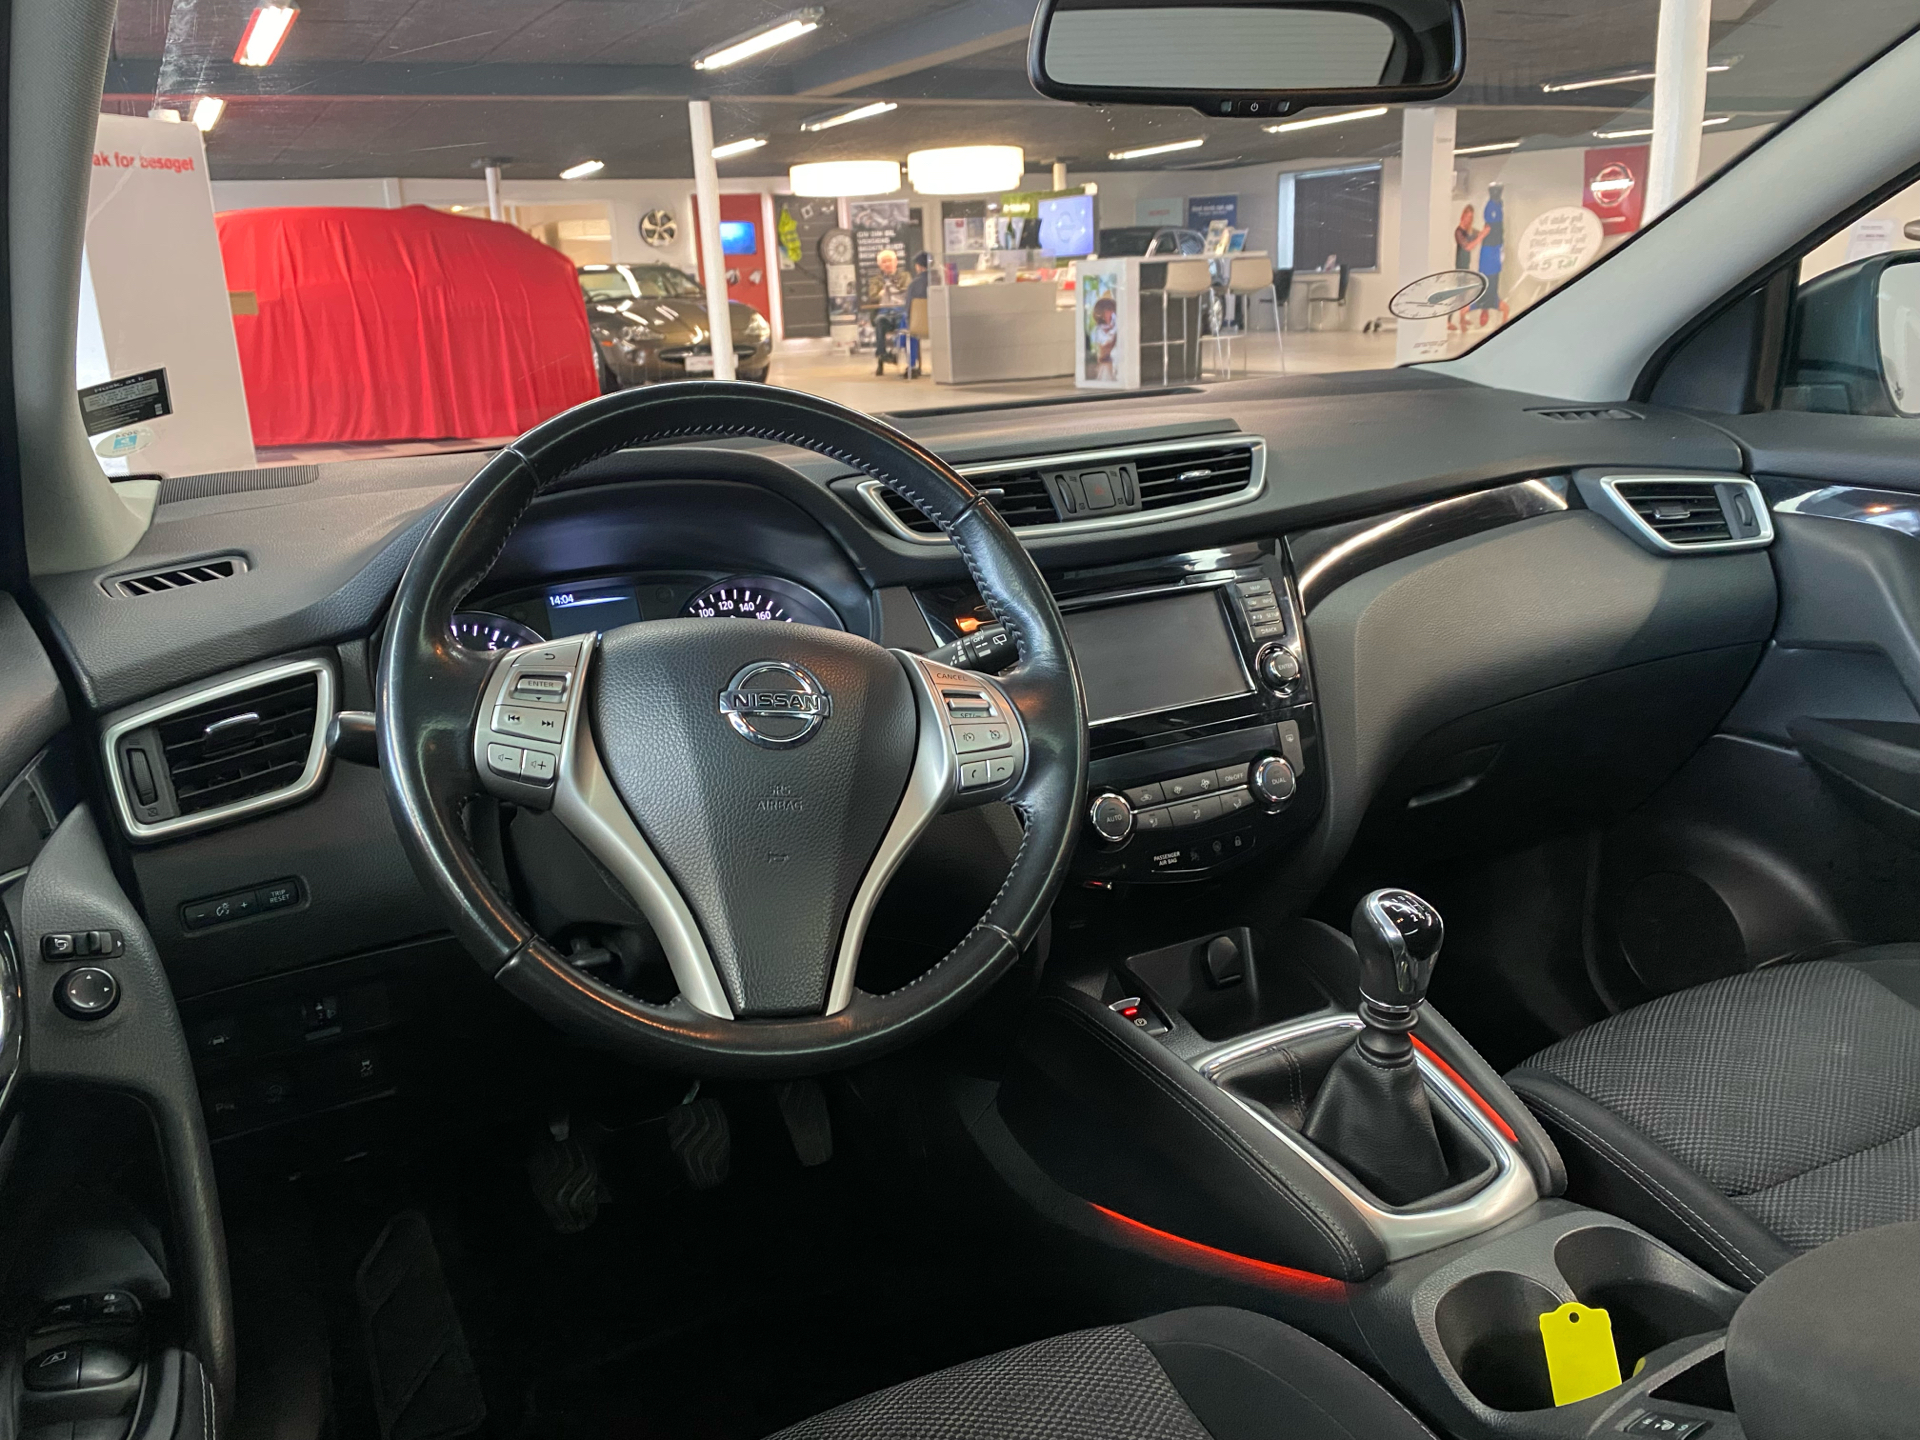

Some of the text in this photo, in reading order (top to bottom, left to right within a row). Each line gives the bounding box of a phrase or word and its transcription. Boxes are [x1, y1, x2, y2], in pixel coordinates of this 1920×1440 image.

[114, 151, 135, 168] for
[549, 594, 574, 605] 14:04
[718, 601, 734, 610] 120
[739, 602, 755, 612] 140
[698, 608, 715, 618] 100
[756, 611, 771, 621] 160
[936, 672, 968, 682] CANCEL
[527, 680, 555, 688] ENTER
[733, 692, 821, 712] NISSAN
[1271, 777, 1287, 785] DUAL
[756, 800, 803, 812] AIRBAG
[1106, 813, 1123, 823] AUTO
[1153, 851, 1180, 862] PASSENGER
[271, 889, 286, 897] TRIP
[269, 894, 290, 904] RESET
